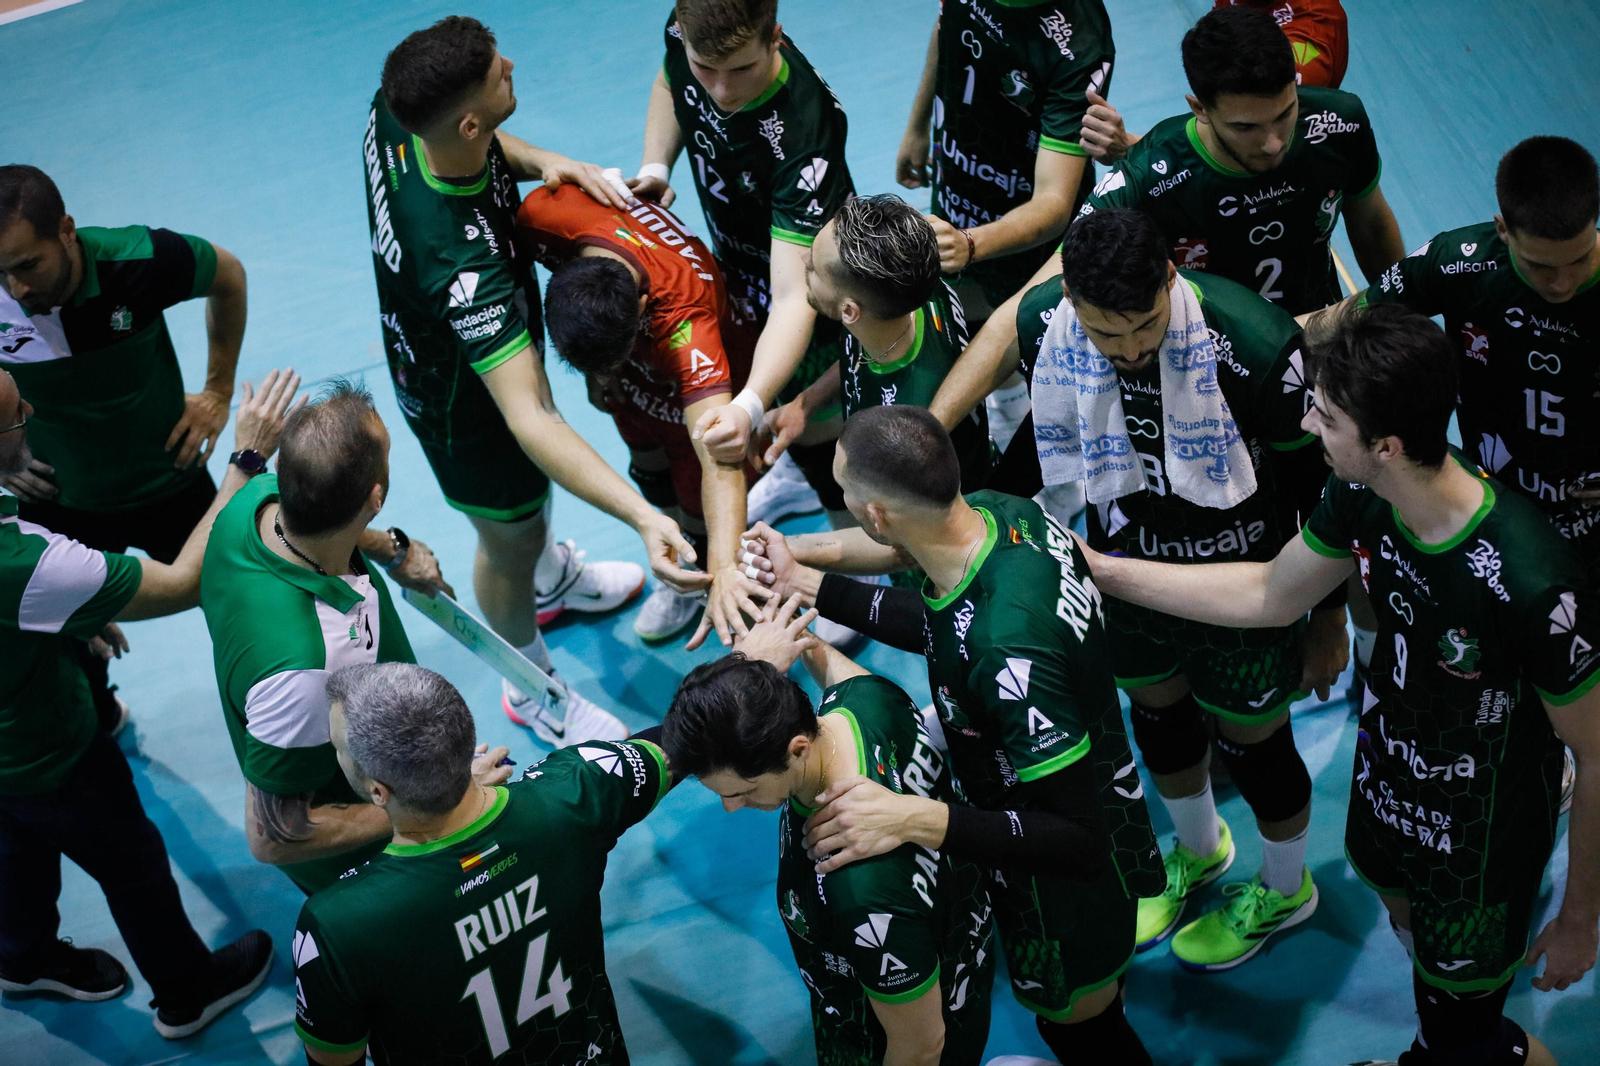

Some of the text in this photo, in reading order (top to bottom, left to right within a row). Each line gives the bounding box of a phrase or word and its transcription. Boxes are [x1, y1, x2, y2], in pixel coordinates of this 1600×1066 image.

[963, 64, 976, 106] 1
[694, 153, 729, 204] 12
[942, 129, 1032, 198] Unicaja
[363, 108, 402, 273] FERNANDO
[945, 185, 991, 222] COSTA
[1243, 180, 1296, 207] Andalucía
[1255, 257, 1284, 299] 2
[1440, 260, 1498, 275] vellsam
[449, 304, 507, 331] Fundación
[458, 319, 503, 341] Unicaja
[1120, 376, 1162, 396] Andaluc
[1522, 387, 1566, 437] 15
[1140, 520, 1265, 557] Unicaja
[1475, 688, 1493, 726] Tulipán
[1038, 731, 1058, 743] Junta
[1039, 731, 1070, 750] Andalucía
[454, 852, 518, 898] #VAMOSVERDES
[454, 873, 547, 963] RUIZ
[459, 929, 573, 1061] 14
[887, 972, 907, 982] Junta
[887, 972, 920, 987] Andalucía
